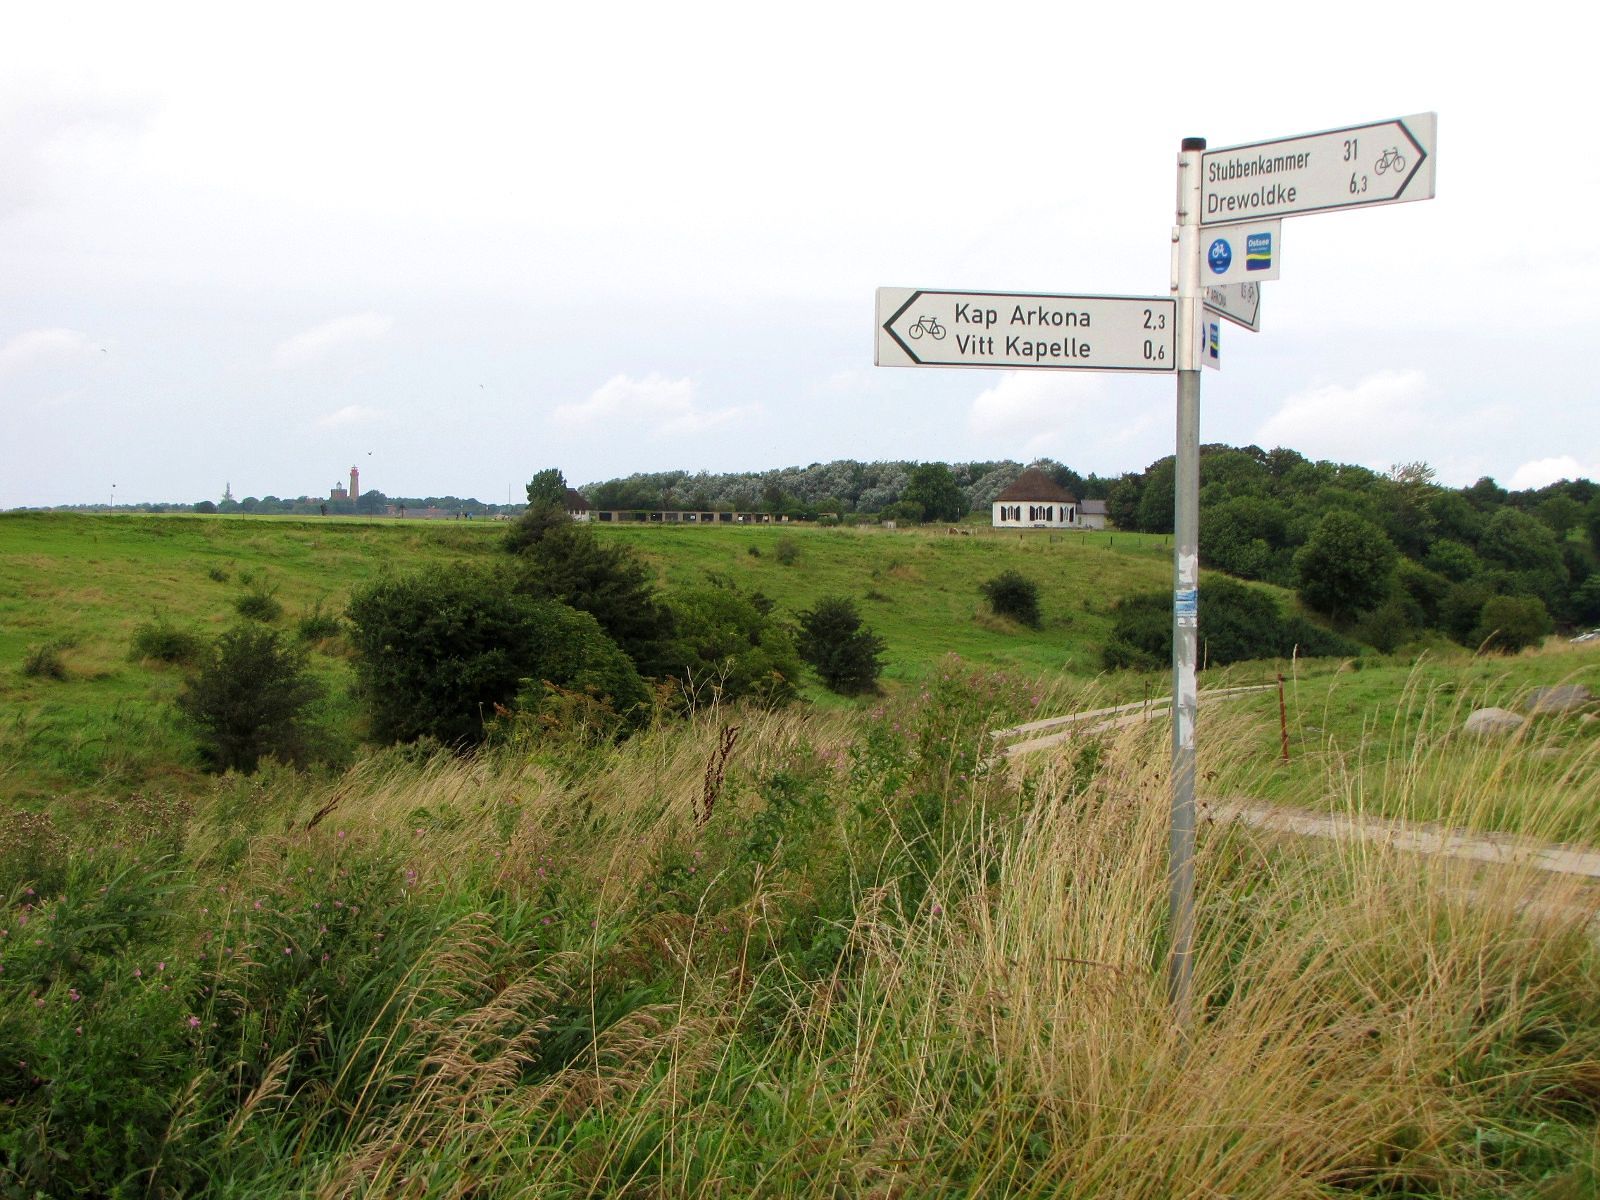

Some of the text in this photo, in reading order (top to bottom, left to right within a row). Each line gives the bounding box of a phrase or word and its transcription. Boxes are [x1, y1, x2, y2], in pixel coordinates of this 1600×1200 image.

[1208, 138, 1358, 183] Stubbenkammer 31
[1208, 172, 1368, 213] Drewoldke 6,3
[955, 303, 1166, 331] Kap Arkona 2,3
[956, 334, 1165, 362] Vitt Kapelle 0,6
